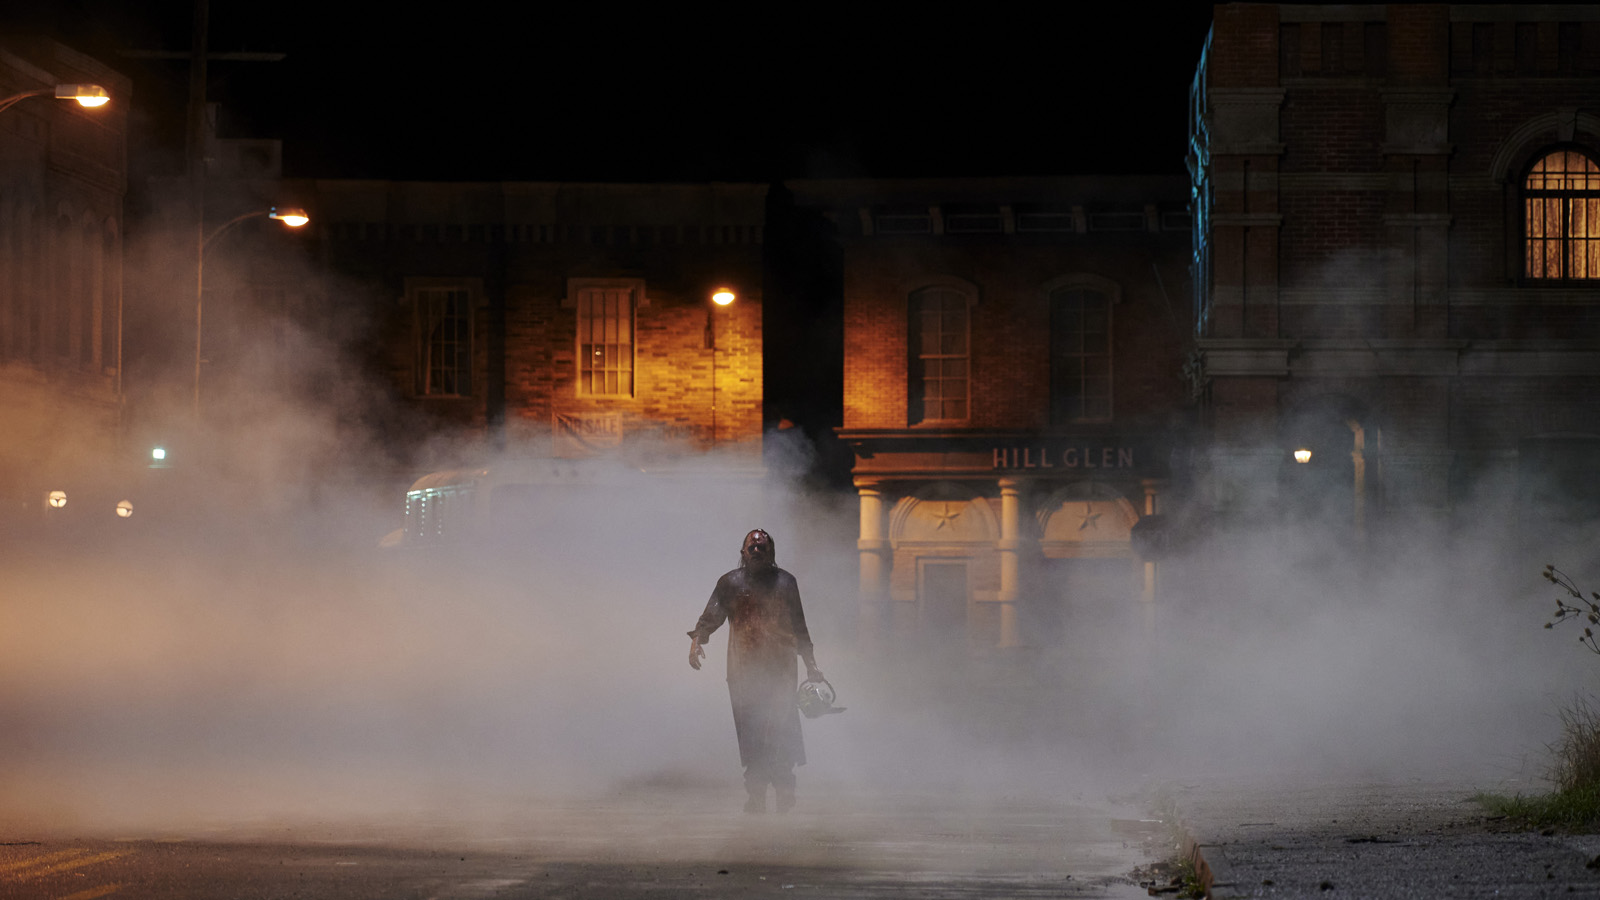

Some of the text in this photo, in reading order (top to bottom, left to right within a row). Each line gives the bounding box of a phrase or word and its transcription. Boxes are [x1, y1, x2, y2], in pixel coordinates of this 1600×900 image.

[585, 418, 616, 433] SALE
[992, 447, 1133, 468] HILL GLEN
